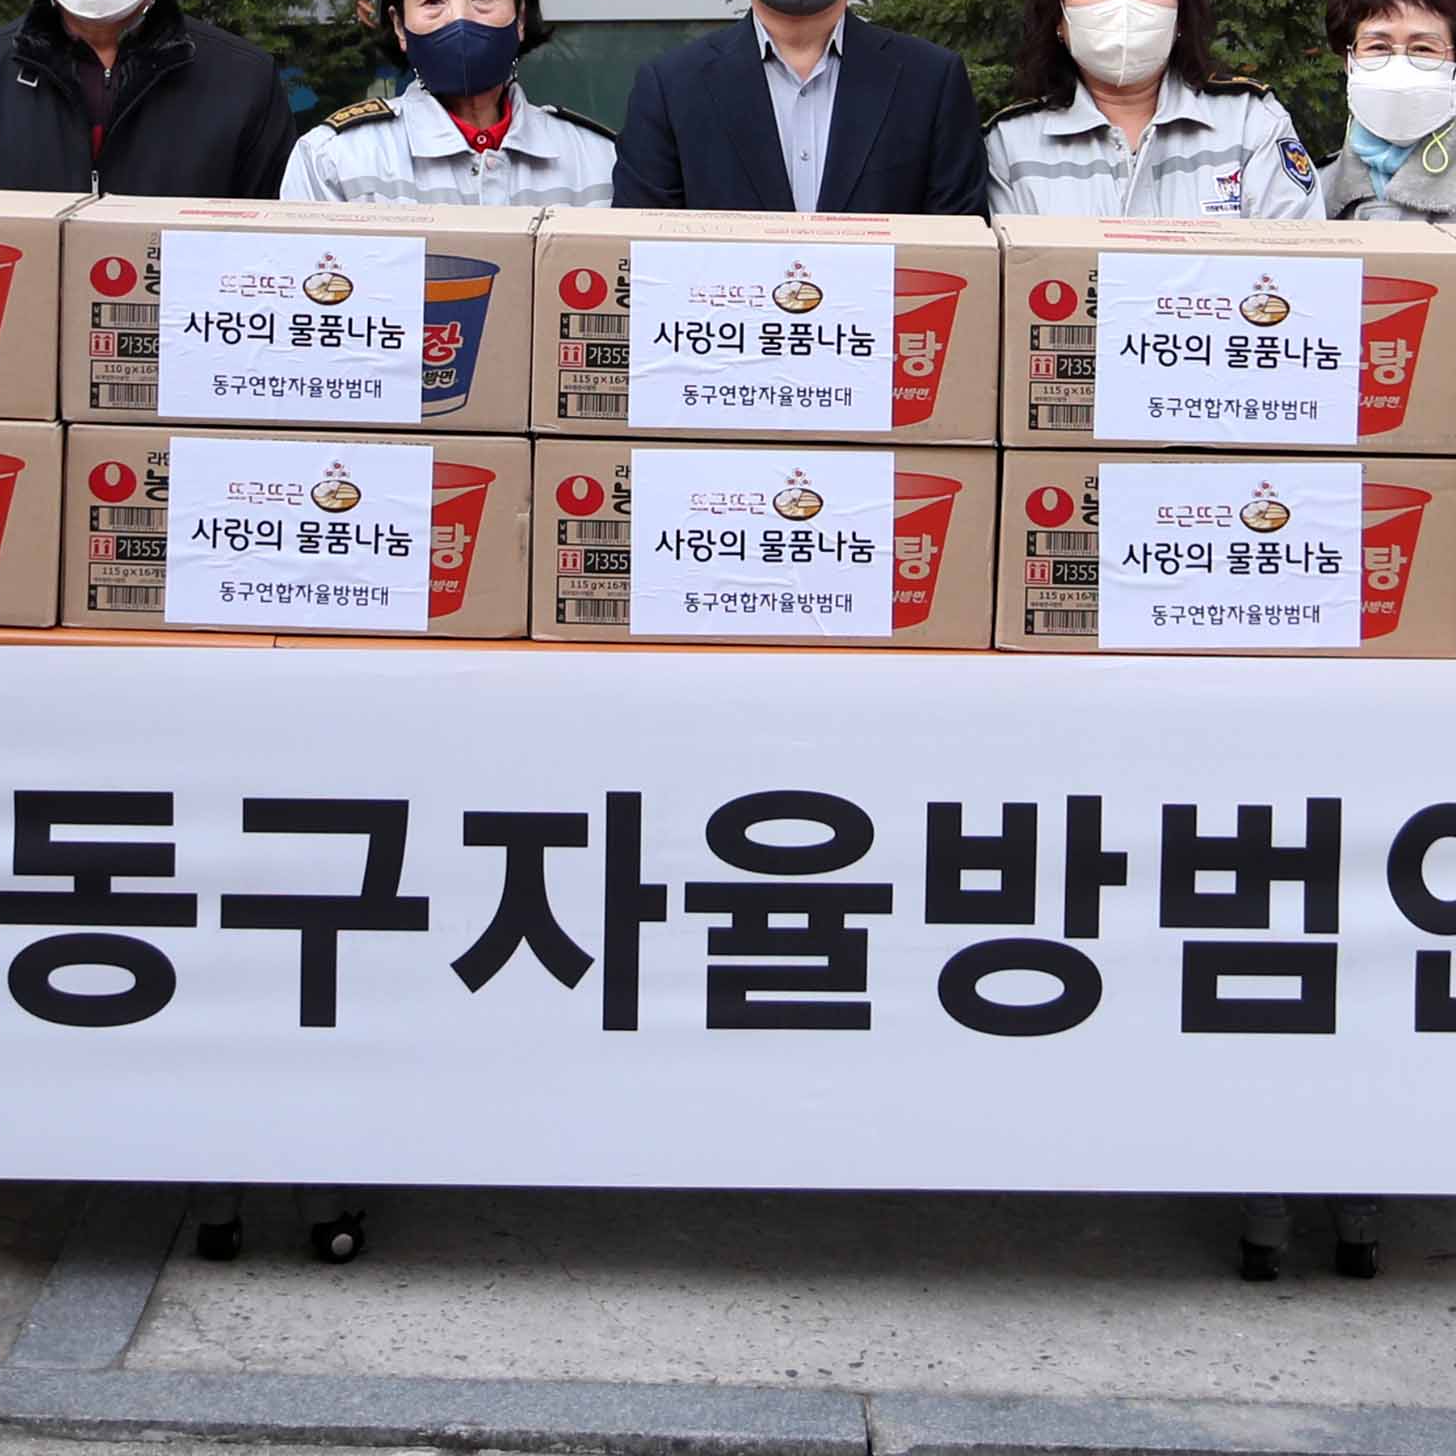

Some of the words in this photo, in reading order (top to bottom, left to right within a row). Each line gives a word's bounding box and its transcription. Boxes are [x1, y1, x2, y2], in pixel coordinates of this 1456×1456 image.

[183, 310, 275, 345] 사랑의
[287, 313, 406, 350] 물품나눔
[653, 320, 745, 356] 사랑의
[757, 322, 876, 357] 물품나눔
[1119, 332, 1211, 368] 사랑의
[1224, 335, 1342, 371] 물품나눔
[211, 374, 382, 400] 동구연합자율방범대
[681, 384, 852, 408] 동구연합자율방범대
[1147, 396, 1318, 421] 동구연합자율방범대
[191, 517, 283, 552] 사랑의
[295, 520, 413, 557] 물품나눔
[654, 528, 746, 563] 사랑의
[758, 529, 876, 564] 물품나눔
[1121, 541, 1213, 576] 사랑의
[1226, 541, 1343, 575] 물품나눔
[219, 581, 389, 607] 동구연합자율방범대
[683, 591, 853, 615] 동구연합자율방범대
[1151, 604, 1321, 627] 동구연합자율방범대
